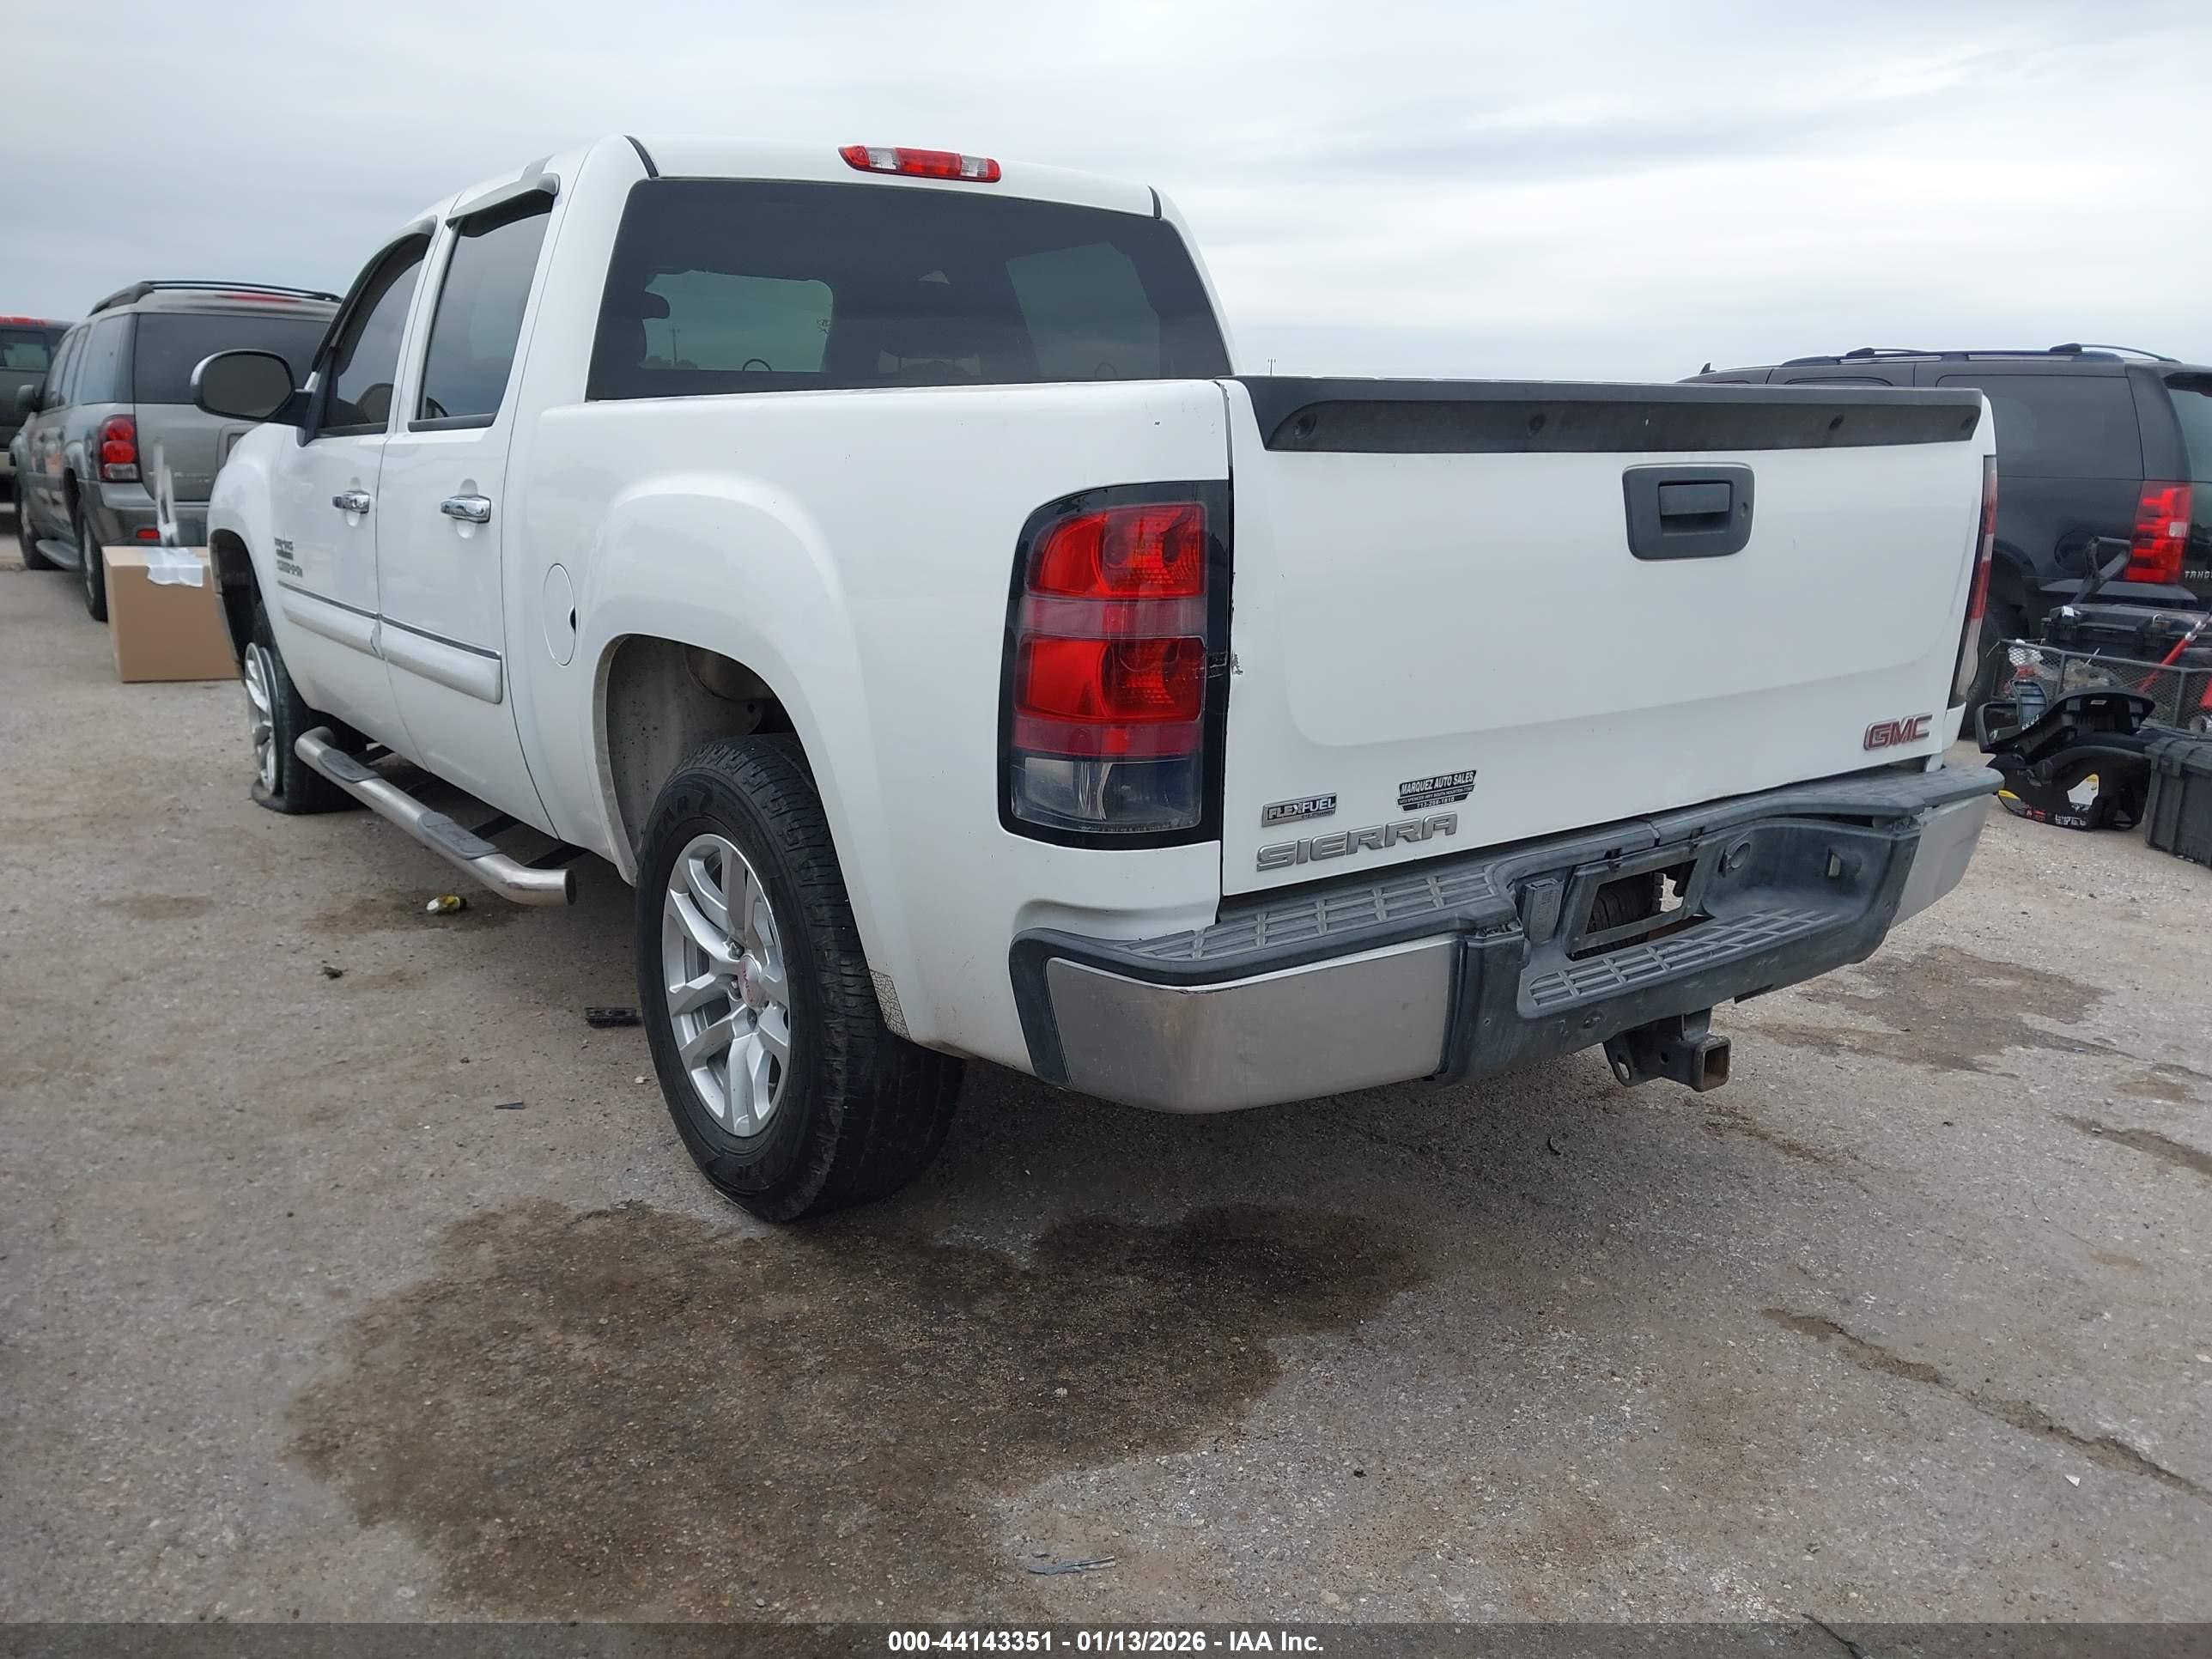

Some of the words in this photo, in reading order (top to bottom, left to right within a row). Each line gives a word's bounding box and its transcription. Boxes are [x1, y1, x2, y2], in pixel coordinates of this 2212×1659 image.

[2184, 570, 2212, 580] TAHO
[1863, 712, 1933, 750] GMC
[1401, 779, 1434, 795] MARQUEZ
[1434, 776, 1452, 789] AUTO
[1453, 771, 1474, 785] SALES
[1268, 798, 1334, 818] FLEXFUEL
[1256, 811, 1458, 872] SIERRA
